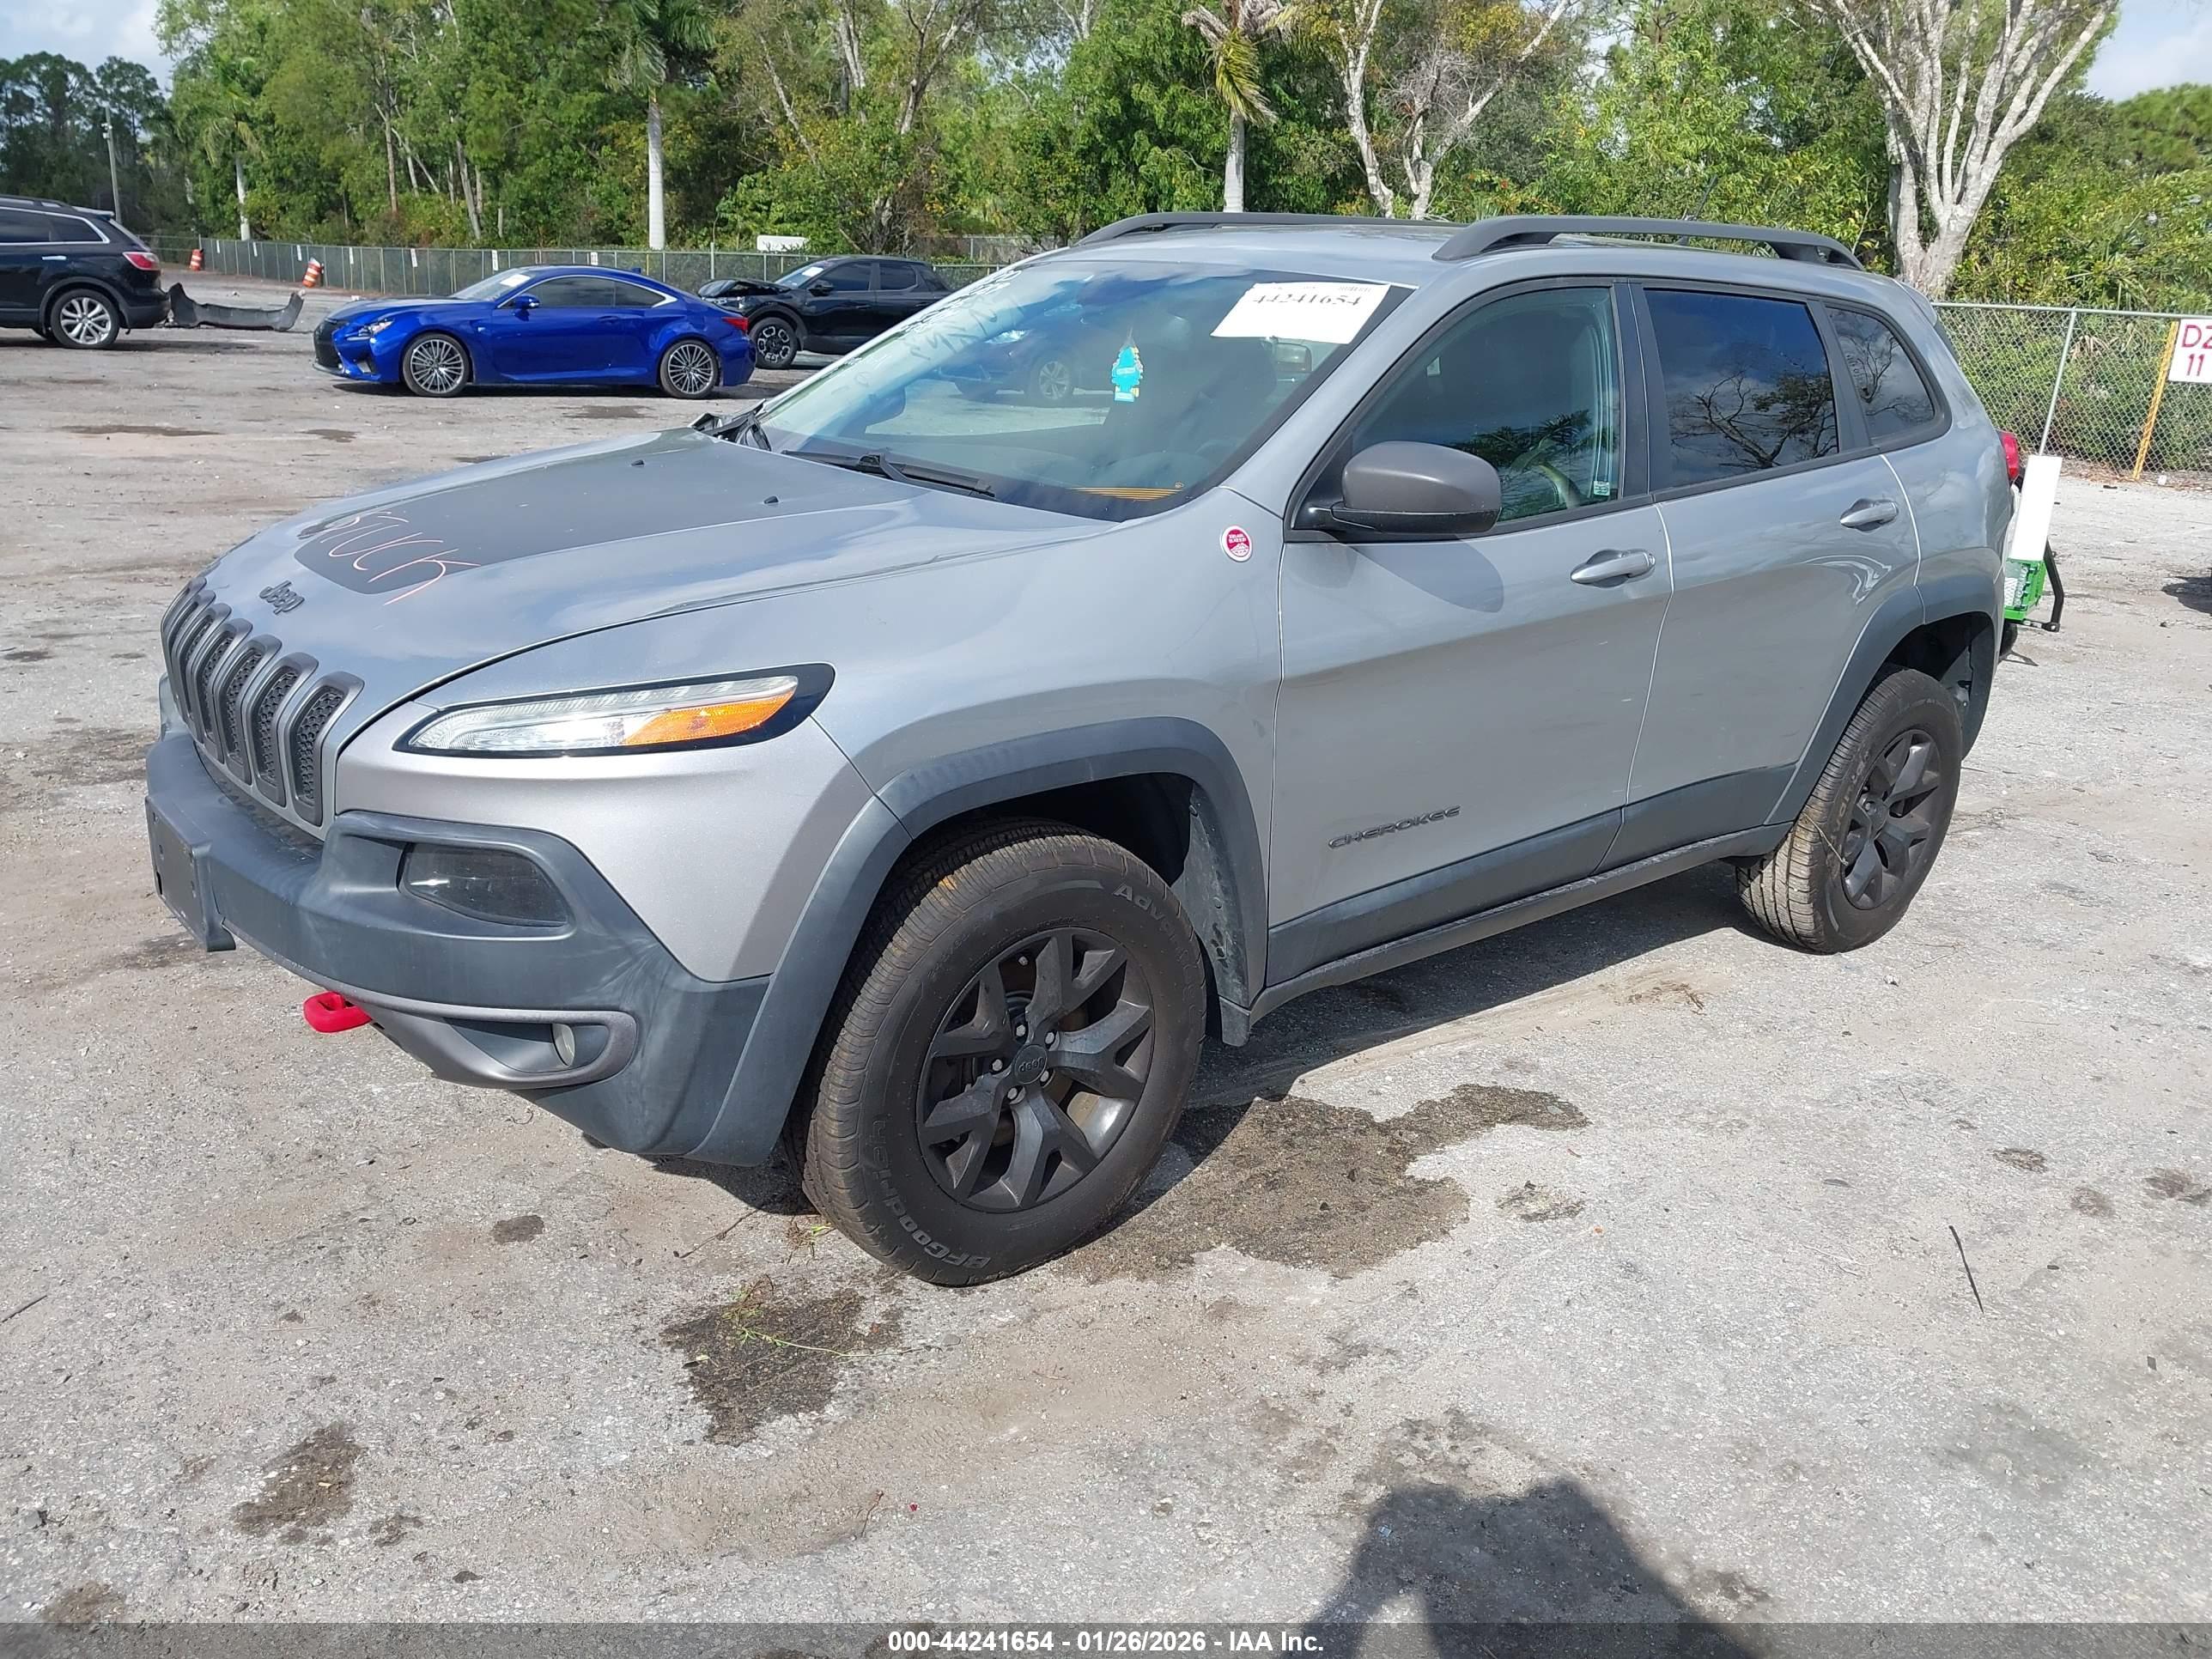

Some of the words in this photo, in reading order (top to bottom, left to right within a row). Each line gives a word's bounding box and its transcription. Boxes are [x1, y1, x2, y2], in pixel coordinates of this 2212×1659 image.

[1254, 294, 1362, 306] 44241654
[2186, 354, 2205, 376] 11
[259, 580, 305, 615] Jeep
[1328, 805, 1461, 849] CHEROKEE
